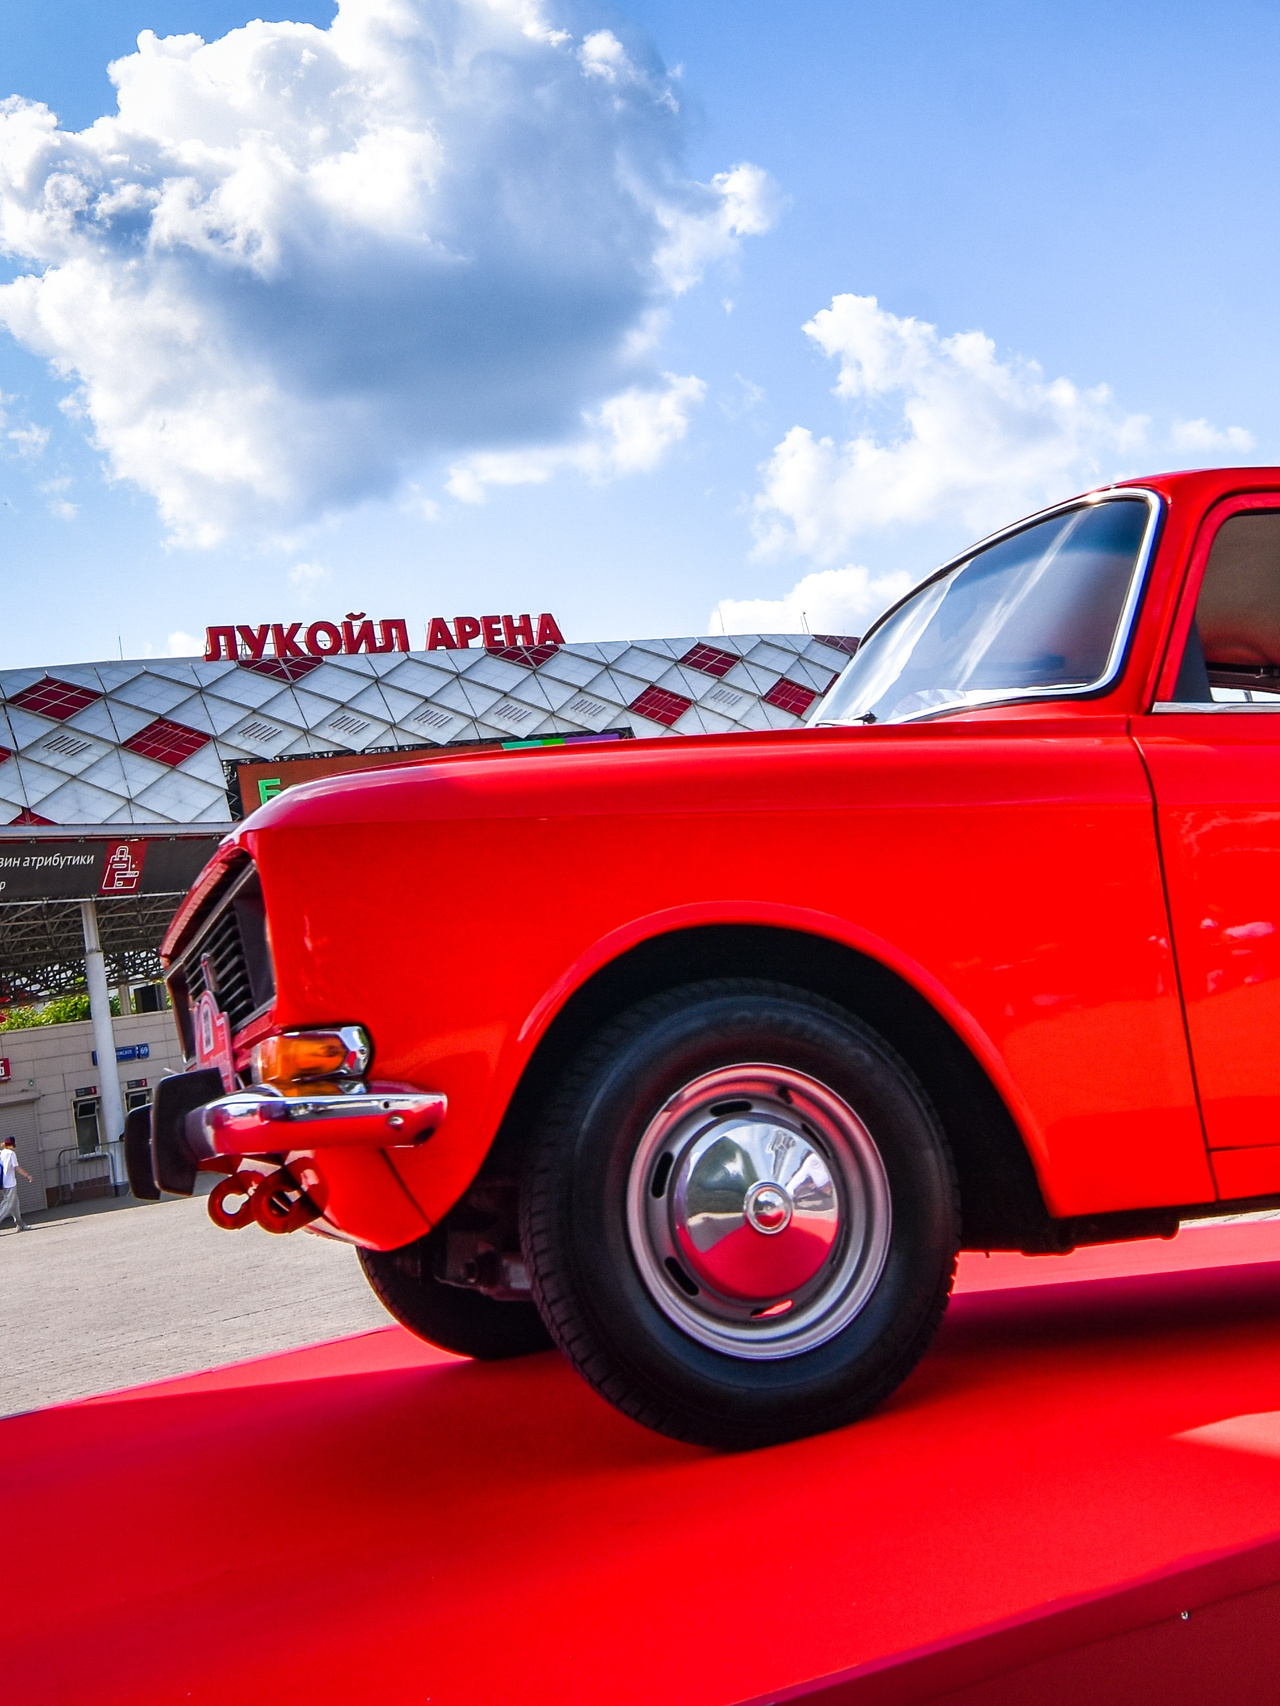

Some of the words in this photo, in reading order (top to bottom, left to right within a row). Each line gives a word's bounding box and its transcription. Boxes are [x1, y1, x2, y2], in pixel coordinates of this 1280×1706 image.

[203, 612, 410, 661] ЛУКОЙЛ
[425, 613, 566, 650] АРЕНА
[22, 853, 94, 870] атрибутики
[140, 1047, 149, 1055] 69
